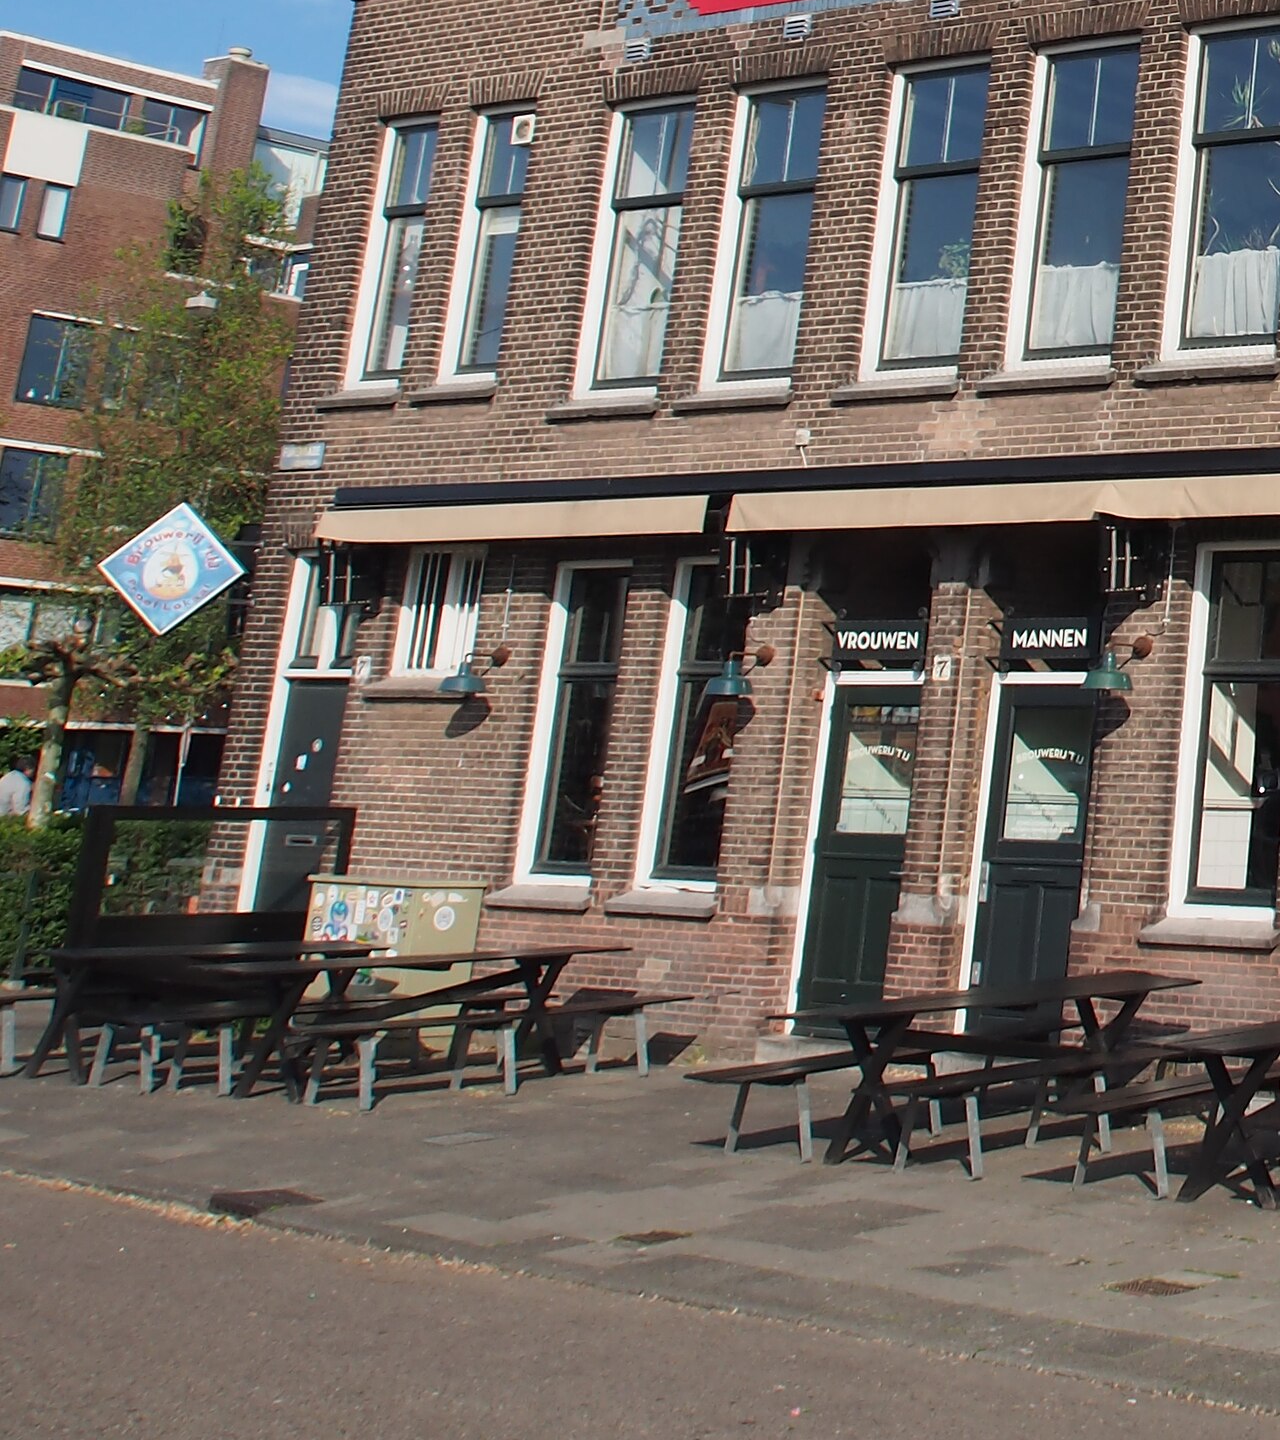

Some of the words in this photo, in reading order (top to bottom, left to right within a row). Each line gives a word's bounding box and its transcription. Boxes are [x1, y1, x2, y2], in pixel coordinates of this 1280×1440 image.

[126, 530, 205, 565] Brouwerij
[837, 631, 919, 650] VROUWEN
[1012, 628, 1087, 649] MANNEN
[936, 660, 949, 678] 7
